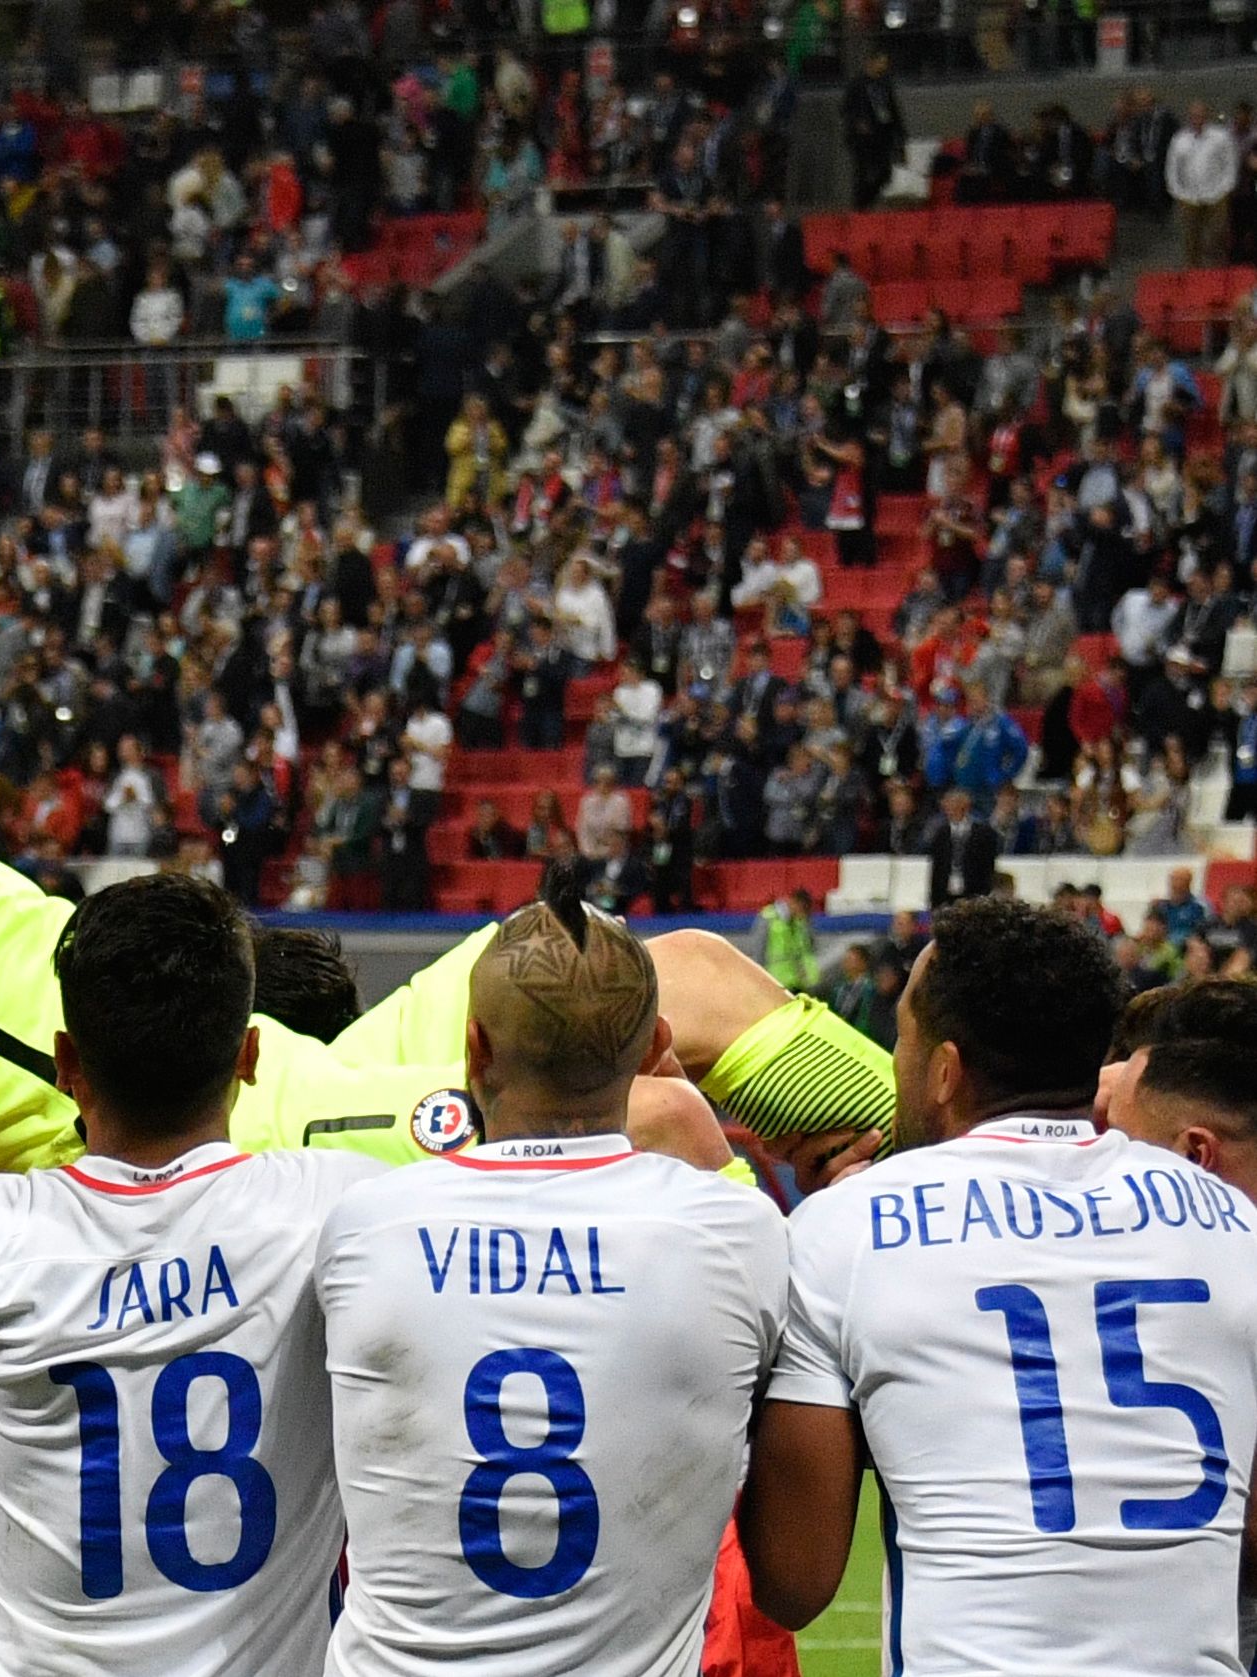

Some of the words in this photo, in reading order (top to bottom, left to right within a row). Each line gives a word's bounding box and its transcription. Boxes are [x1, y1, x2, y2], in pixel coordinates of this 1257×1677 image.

[501, 1144, 518, 1156] LA
[523, 1143, 564, 1157] ROJA
[1021, 1123, 1040, 1136] LA
[1044, 1124, 1078, 1138] ROJA
[133, 1171, 151, 1181] LA
[869, 1169, 1251, 1251] BEAUSEJOUR
[86, 1244, 240, 1331] JARA
[417, 1225, 626, 1296] VIDAL
[975, 1277, 1230, 1533] 15
[48, 1350, 277, 1600] 18
[458, 1346, 601, 1600] 8
